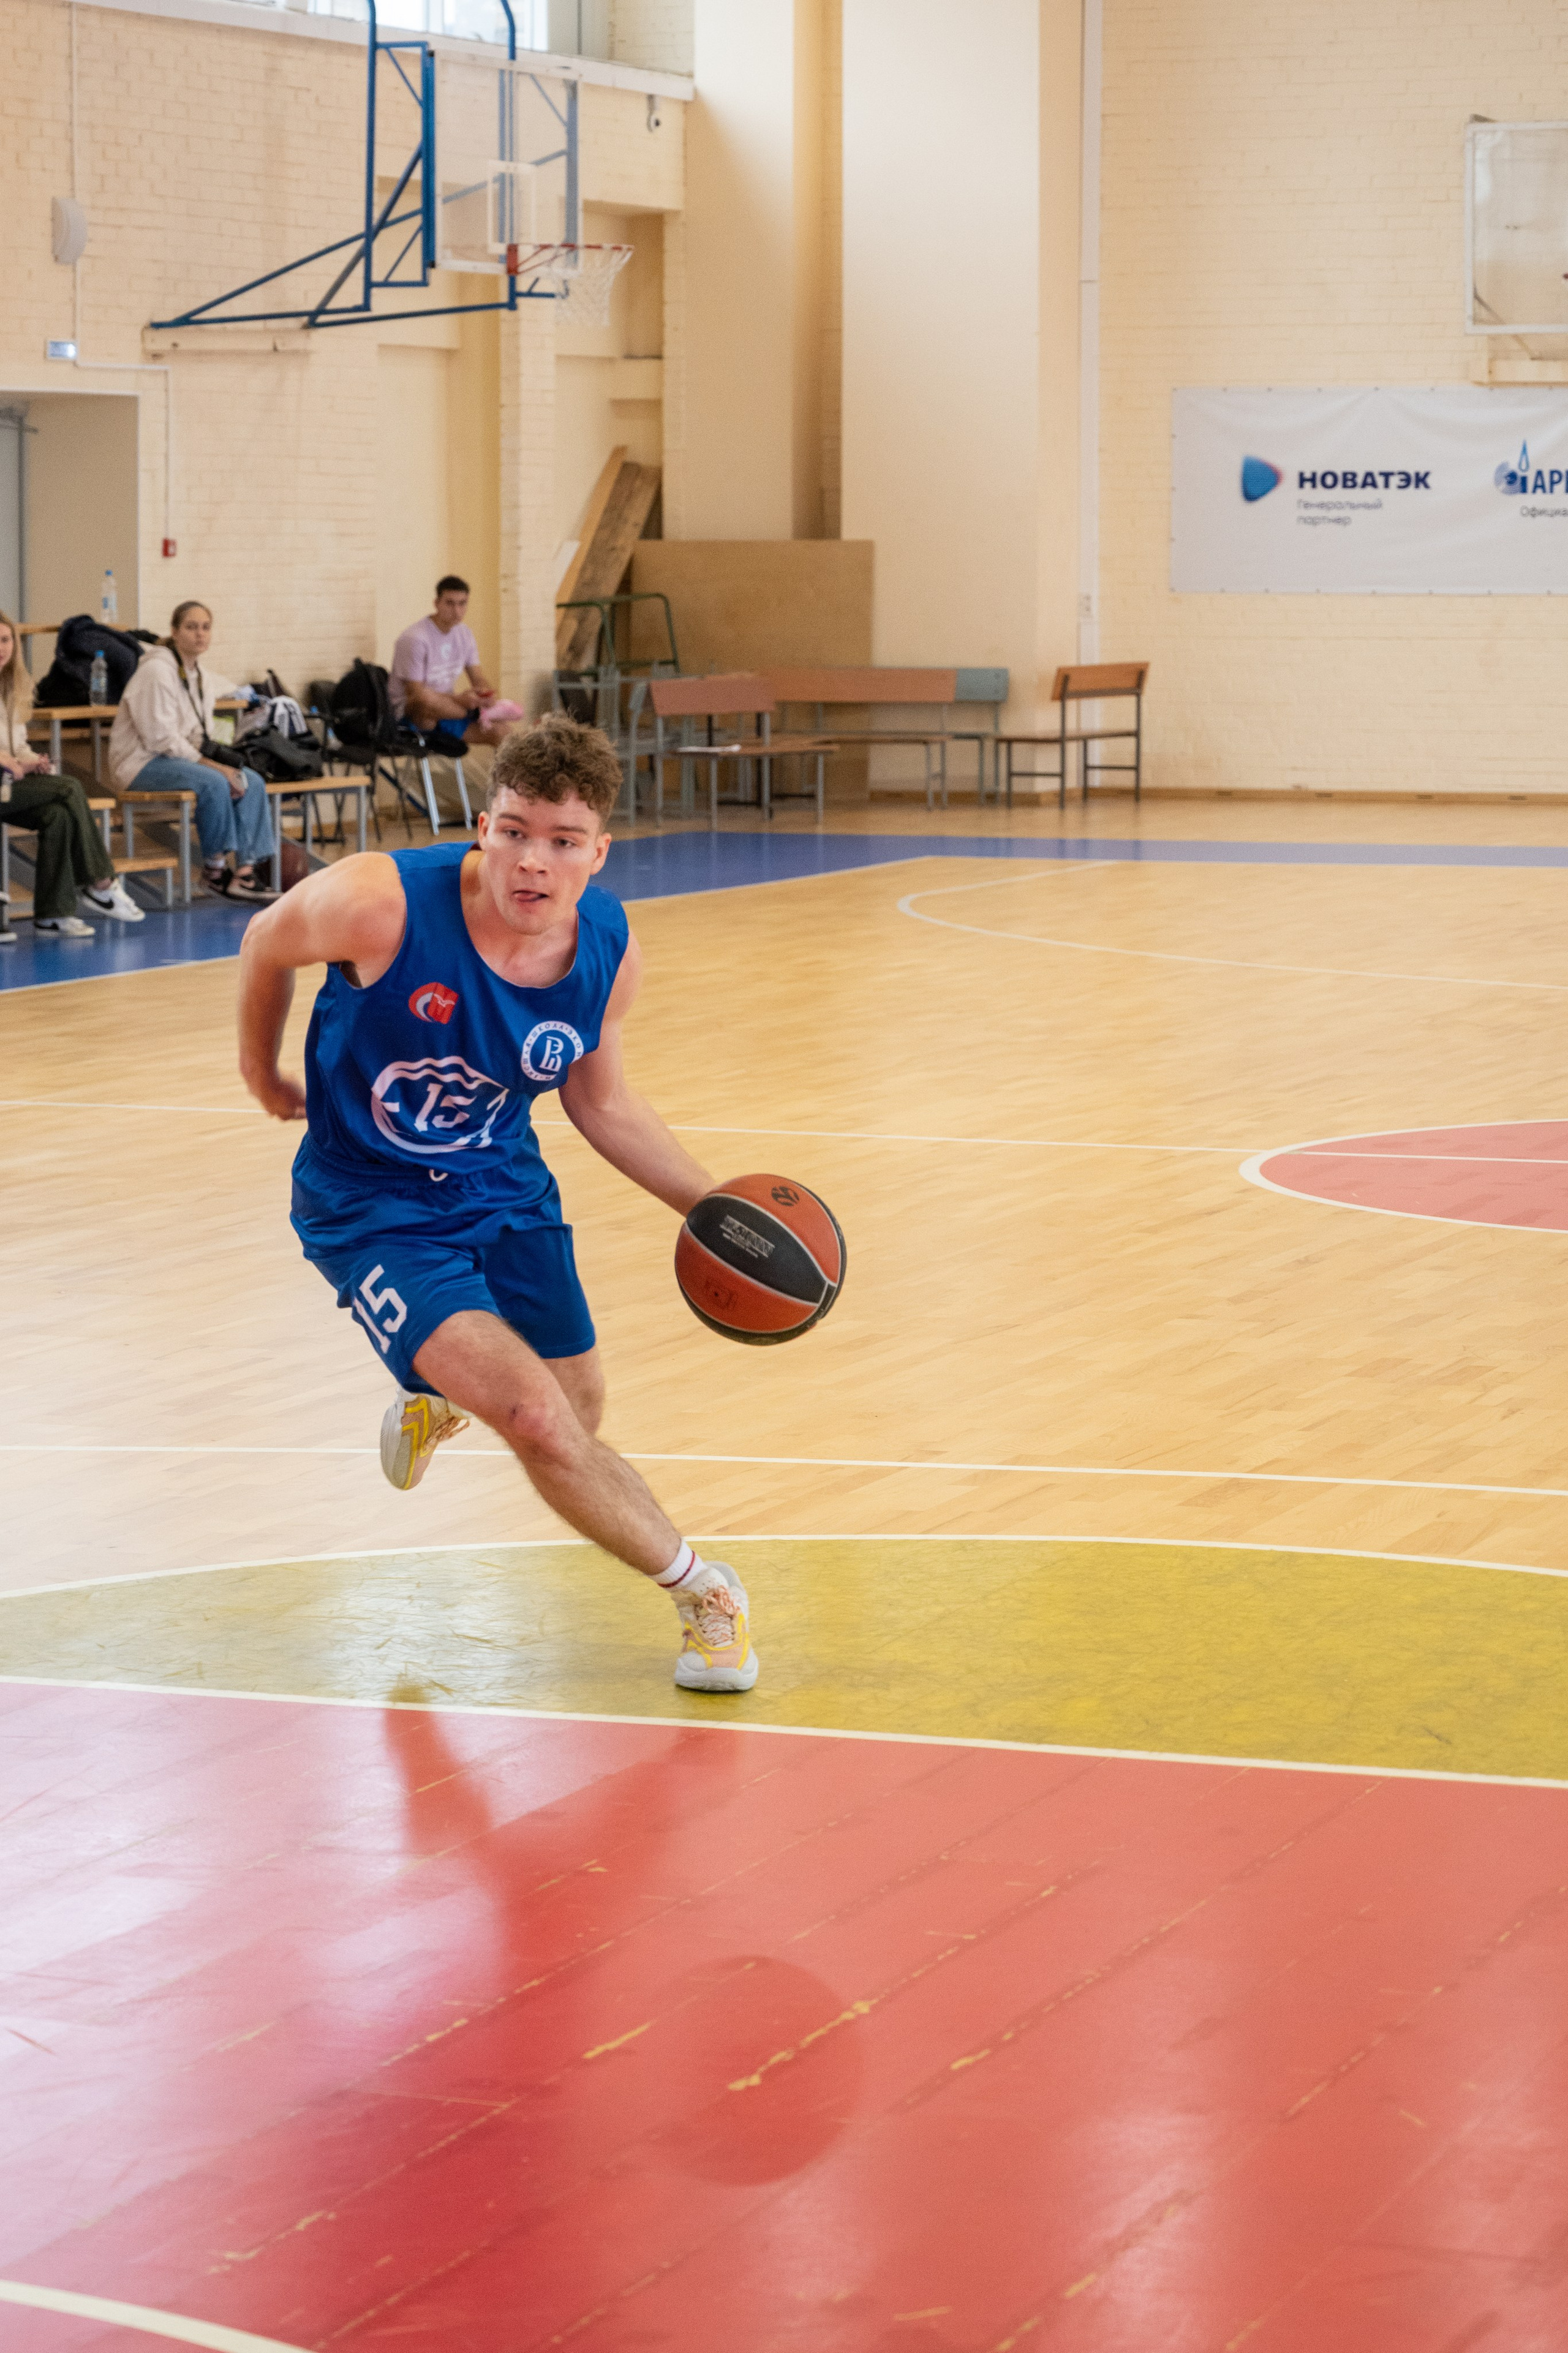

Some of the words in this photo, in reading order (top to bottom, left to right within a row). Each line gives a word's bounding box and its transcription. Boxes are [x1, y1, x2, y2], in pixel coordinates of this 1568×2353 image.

[1298, 470, 1431, 489] НОВАТЭК
[1297, 498, 1382, 512] Генеральный
[531, 1022, 564, 1038] ШКОЛА
[413, 1082, 477, 1133] 15
[353, 1264, 407, 1354] 15
